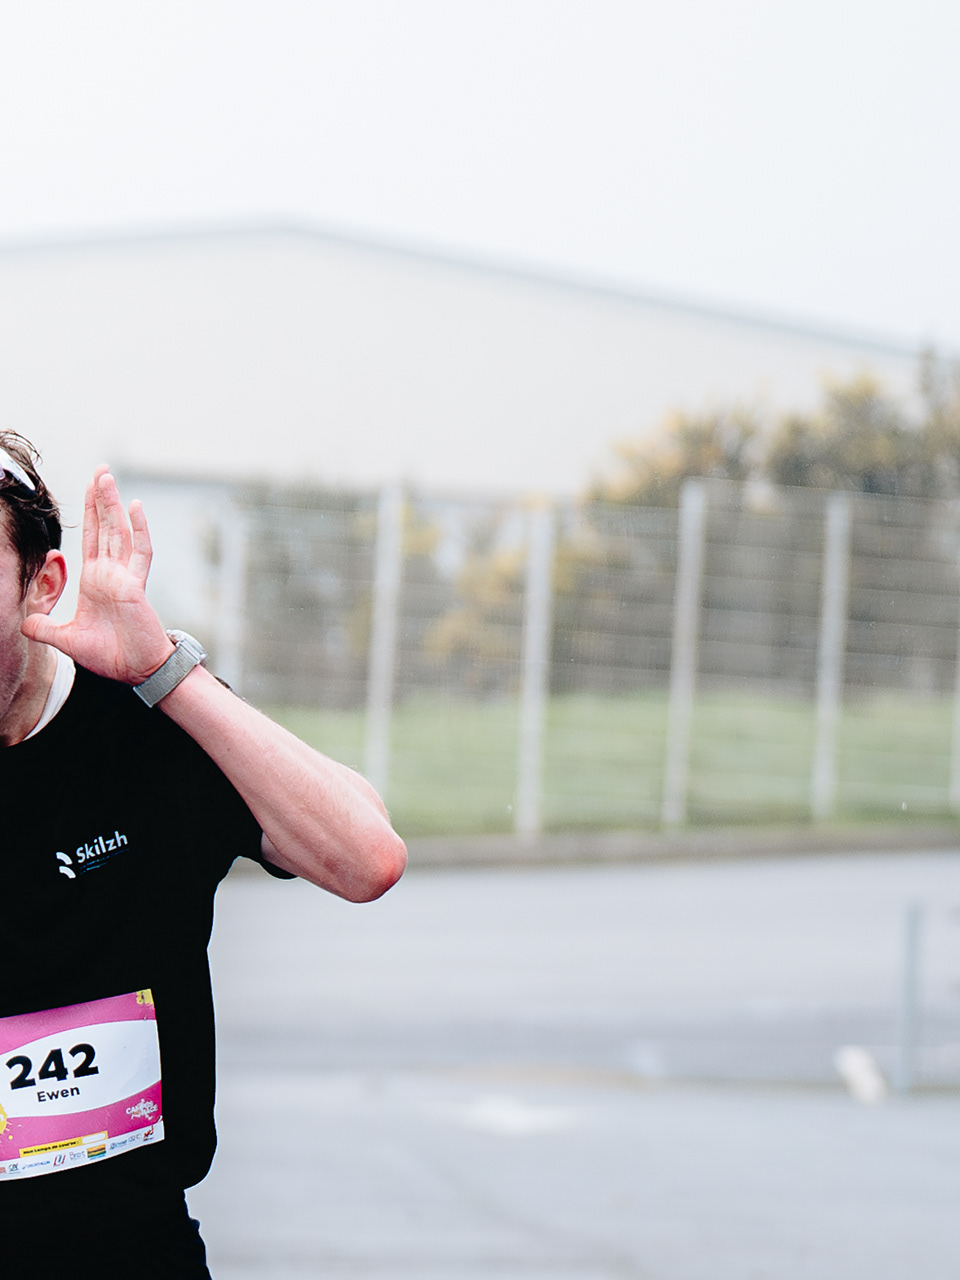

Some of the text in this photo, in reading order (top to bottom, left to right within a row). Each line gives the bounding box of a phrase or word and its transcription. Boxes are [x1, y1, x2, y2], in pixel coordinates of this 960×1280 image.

[76, 830, 128, 863] Skilzh
[5, 1043, 99, 1090] 242
[37, 1086, 81, 1102] Ewen
